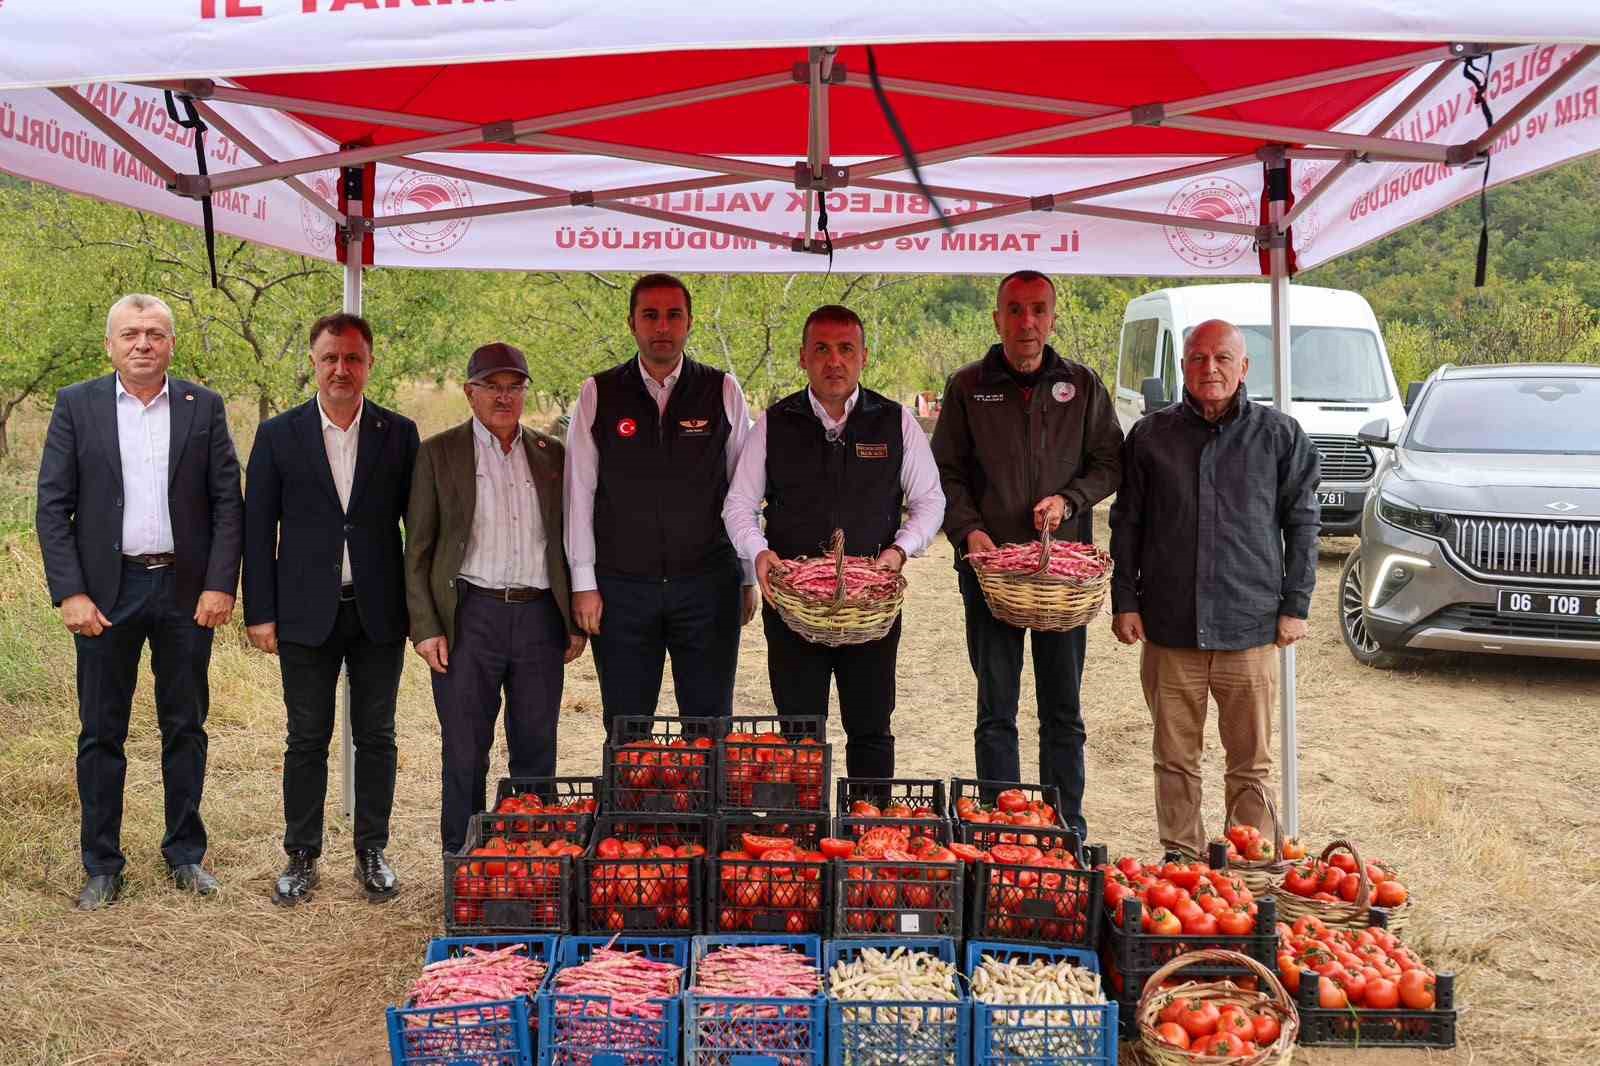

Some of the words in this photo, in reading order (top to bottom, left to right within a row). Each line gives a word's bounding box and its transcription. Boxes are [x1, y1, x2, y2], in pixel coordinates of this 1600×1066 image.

[1321, 493, 1342, 504] 781
[1510, 593, 1532, 612] 06
[1547, 595, 1580, 615] TOB
